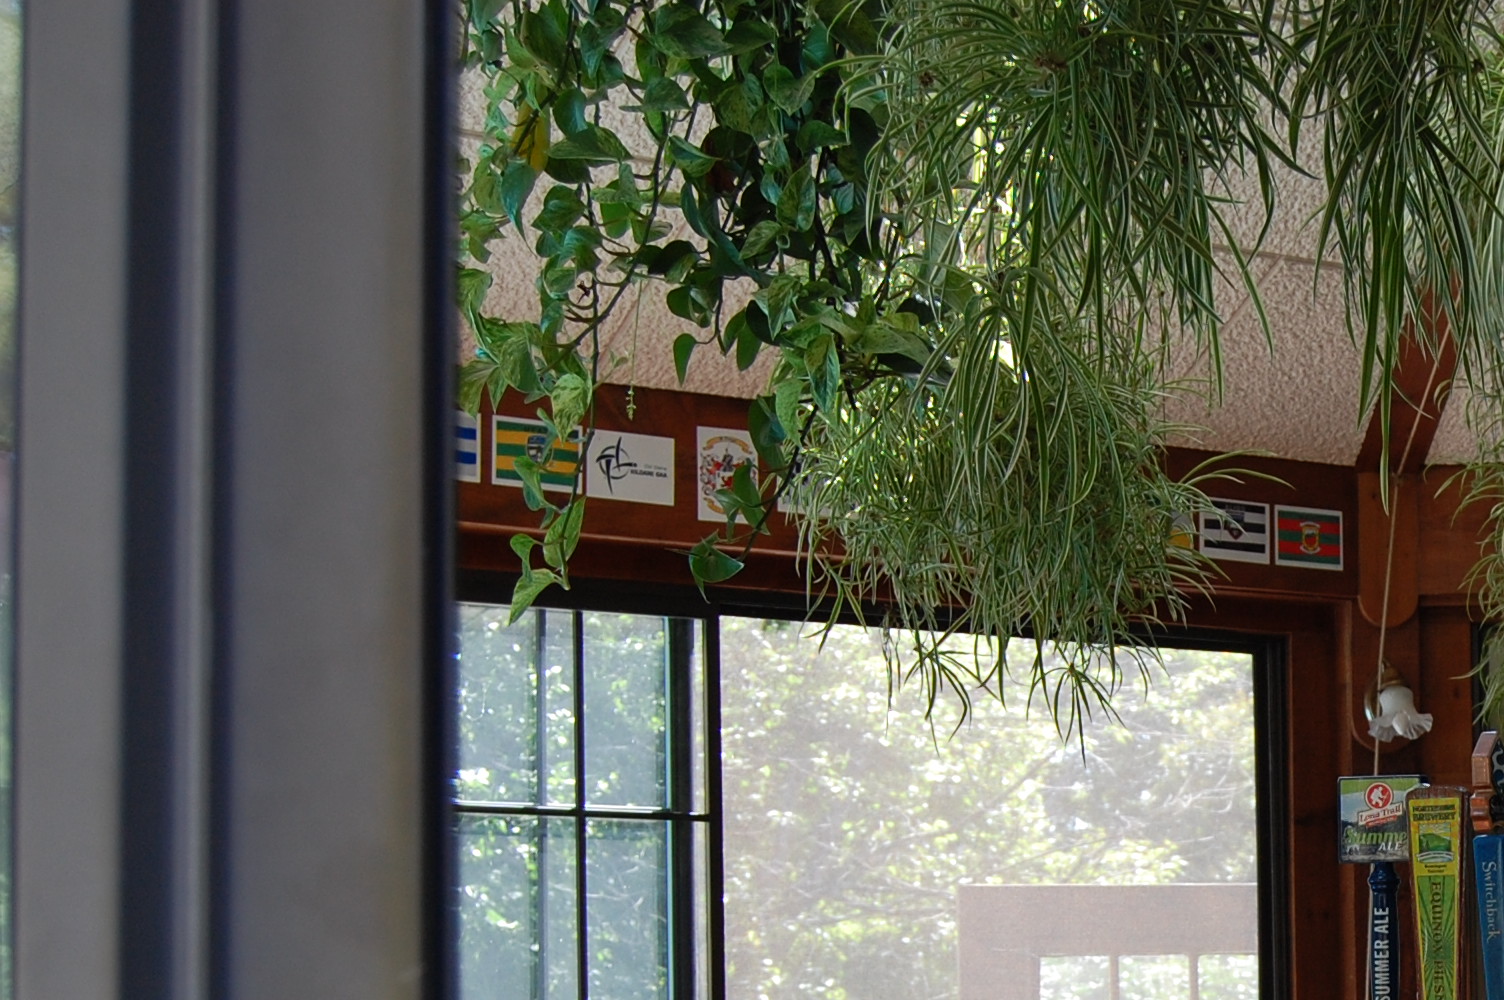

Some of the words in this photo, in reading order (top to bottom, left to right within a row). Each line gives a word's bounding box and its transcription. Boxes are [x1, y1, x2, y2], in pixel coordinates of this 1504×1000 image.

[1378, 841, 1404, 851] ALE
[1374, 906, 1389, 937] ALE
[1431, 881, 1442, 954] EQUINOX
[1482, 861, 1499, 943] Switchback
